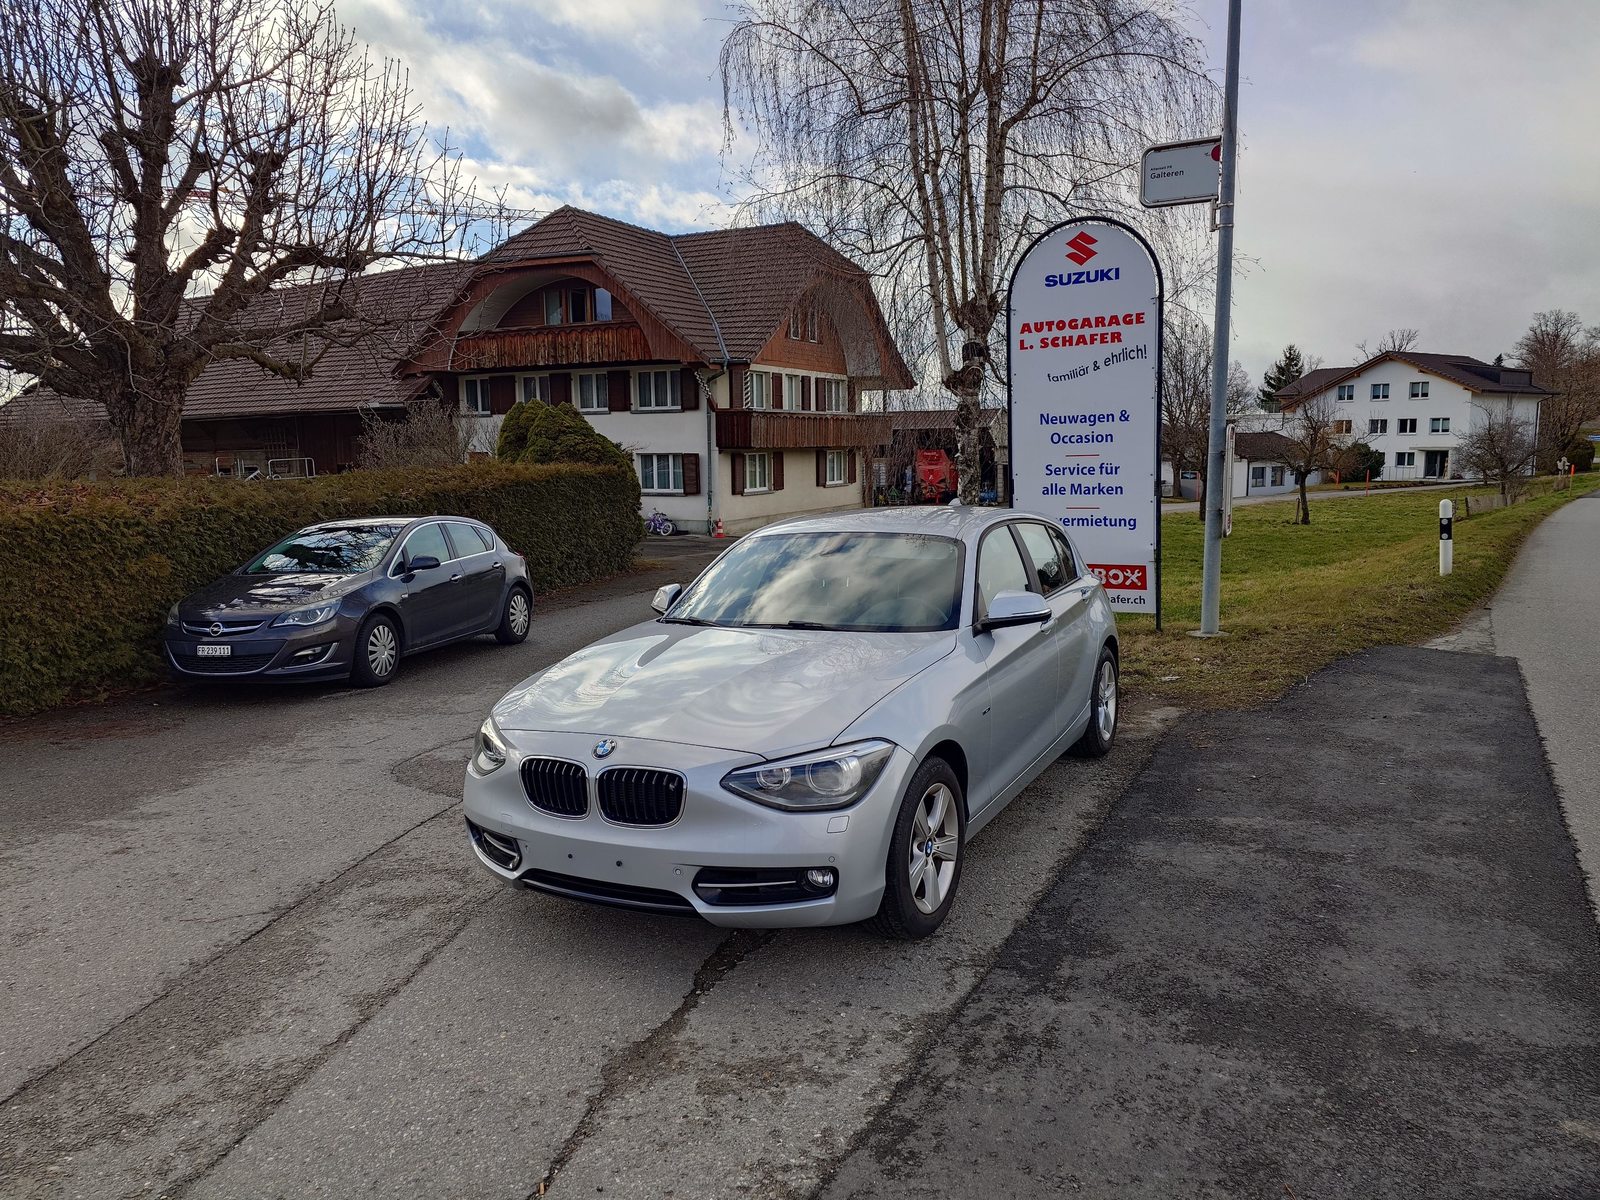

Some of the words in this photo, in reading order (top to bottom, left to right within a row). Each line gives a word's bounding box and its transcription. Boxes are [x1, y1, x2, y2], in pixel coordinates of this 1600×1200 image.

[1150, 170, 1184, 179] Galteren
[1044, 267, 1120, 288] SUZUKI
[1020, 312, 1145, 335] AUTOGARAGE
[1019, 340, 1034, 351] L.
[1039, 331, 1123, 349] SCHAFER
[1047, 366, 1090, 382] familiär
[1092, 360, 1101, 371] &
[1103, 344, 1148, 367] ehrlich!
[1039, 412, 1115, 427] Neuwagen
[1118, 409, 1130, 422] &
[1050, 430, 1114, 445] Occasion
[1045, 463, 1096, 476] Service
[1099, 462, 1121, 475] für
[1042, 482, 1067, 495] alle
[1069, 482, 1124, 495] Marken
[1089, 568, 1142, 586] BOX
[1108, 594, 1146, 605] afer.ch
